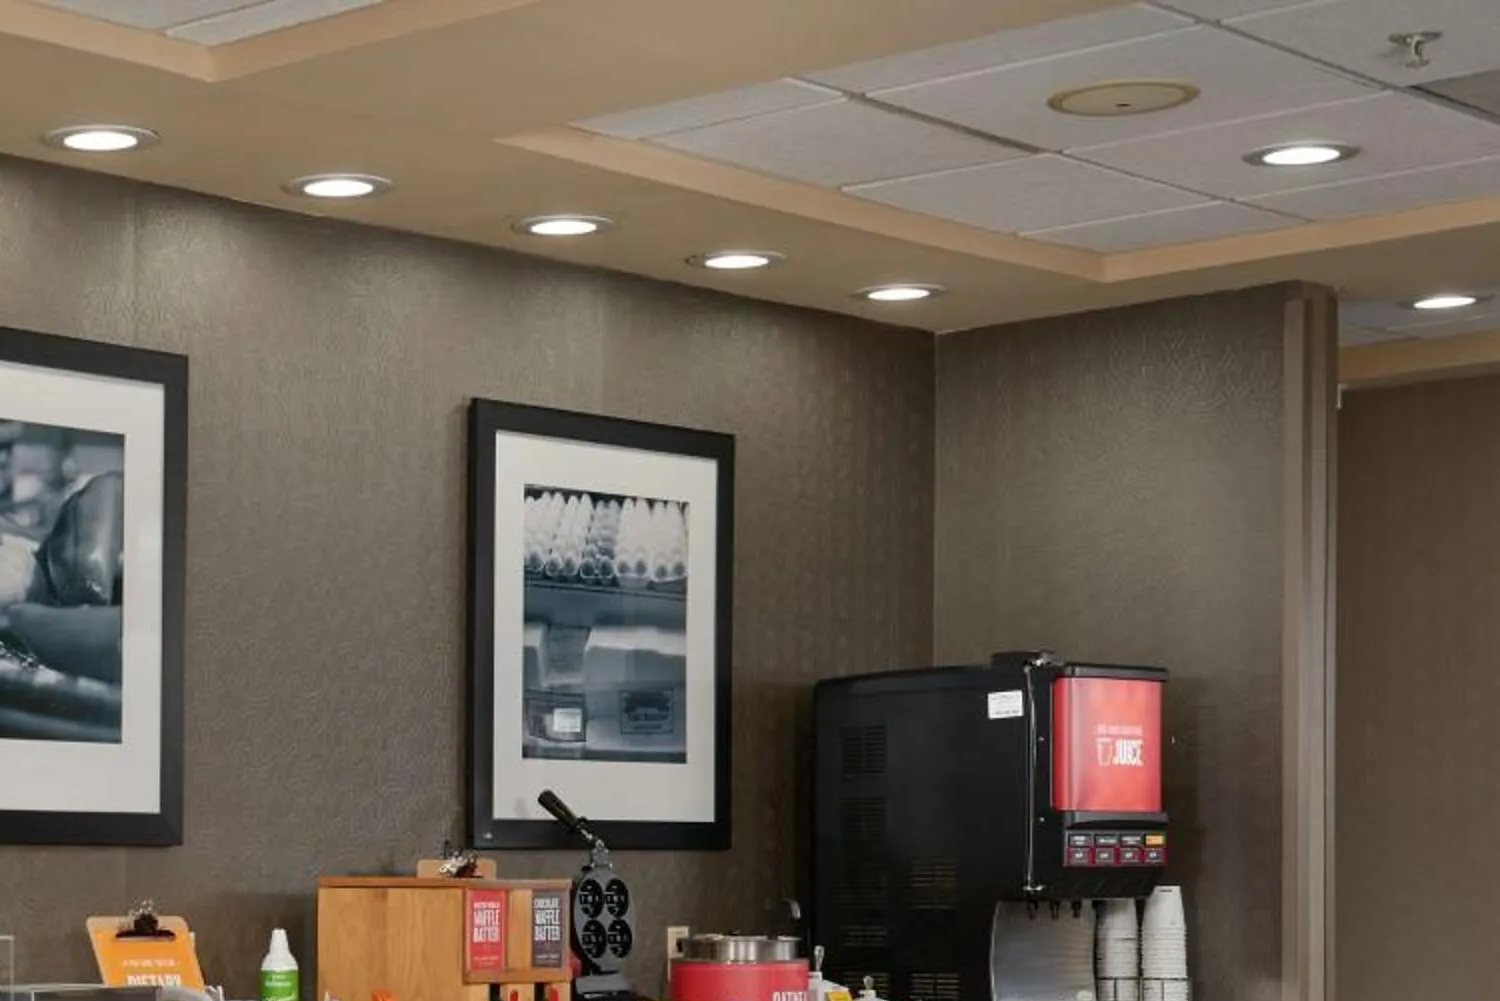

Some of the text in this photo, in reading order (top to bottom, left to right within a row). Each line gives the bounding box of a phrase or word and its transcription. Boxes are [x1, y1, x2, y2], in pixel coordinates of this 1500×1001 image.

[1112, 738, 1145, 767] JUICE
[473, 909, 501, 926] WAFFLE
[534, 909, 561, 925] WAFFLE
[533, 925, 561, 941] BATTER
